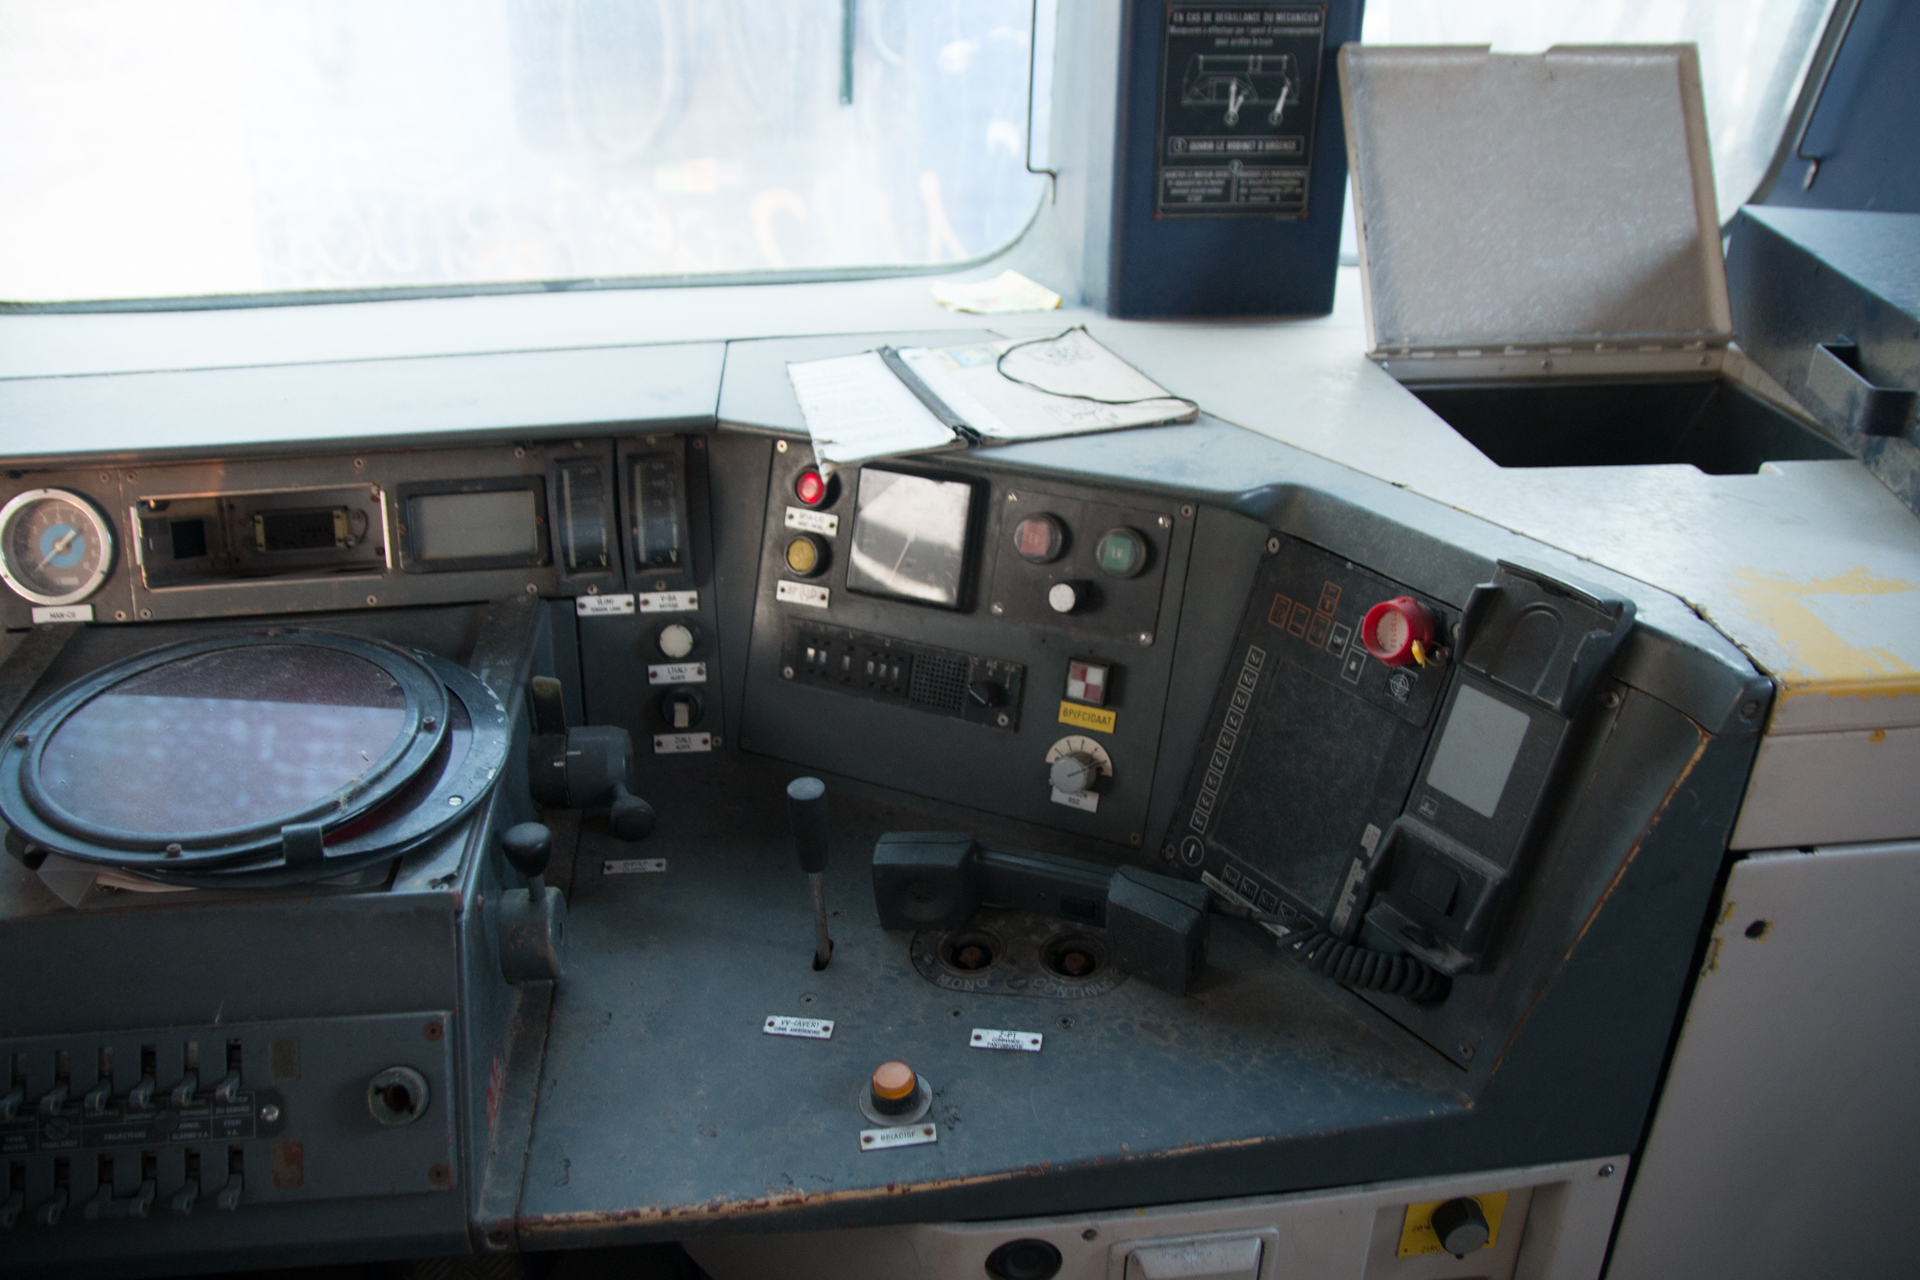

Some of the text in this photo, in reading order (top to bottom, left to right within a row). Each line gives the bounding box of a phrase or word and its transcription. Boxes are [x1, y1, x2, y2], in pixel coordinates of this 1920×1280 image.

[1186, 12, 1202, 22] CAS
[1203, 12, 1213, 22] DE
[936, 973, 989, 992] MONO
